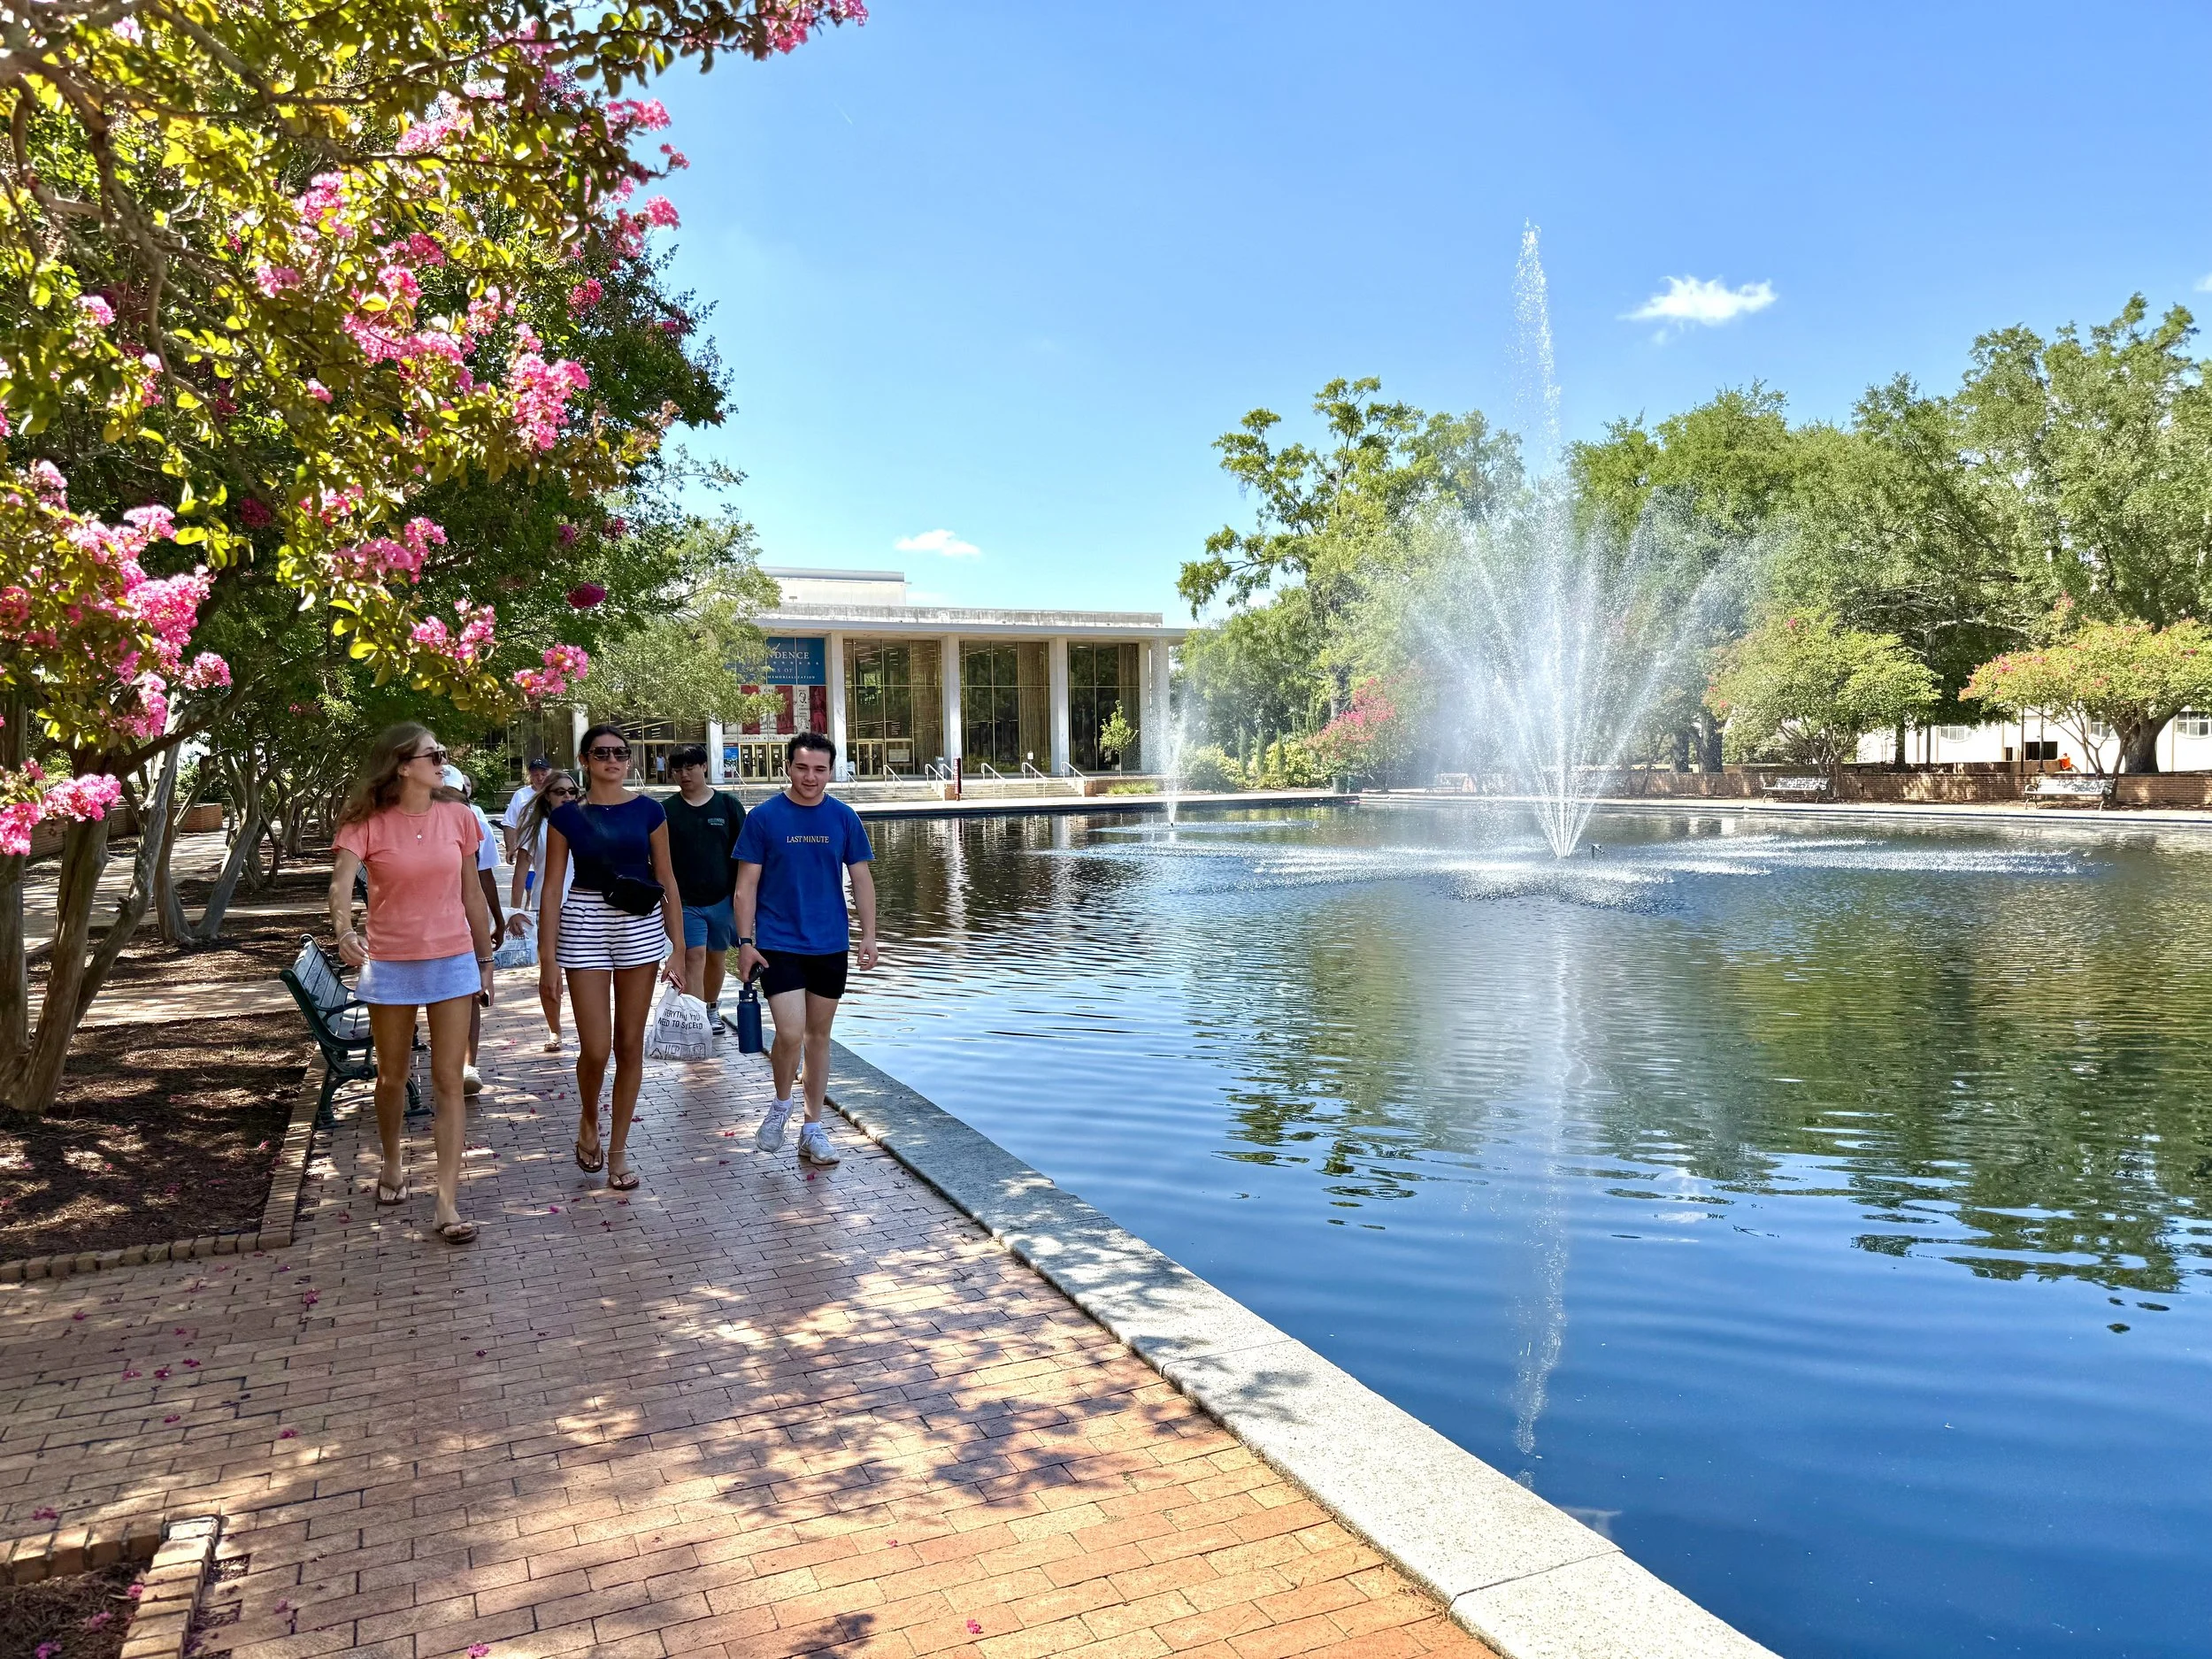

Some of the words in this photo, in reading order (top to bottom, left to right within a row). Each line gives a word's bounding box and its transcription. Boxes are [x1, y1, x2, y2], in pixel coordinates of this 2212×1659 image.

[664, 1009, 687, 1021] EVERYTHIN
[657, 1017, 671, 1026] NEED
[680, 1021, 703, 1030] SCEED
